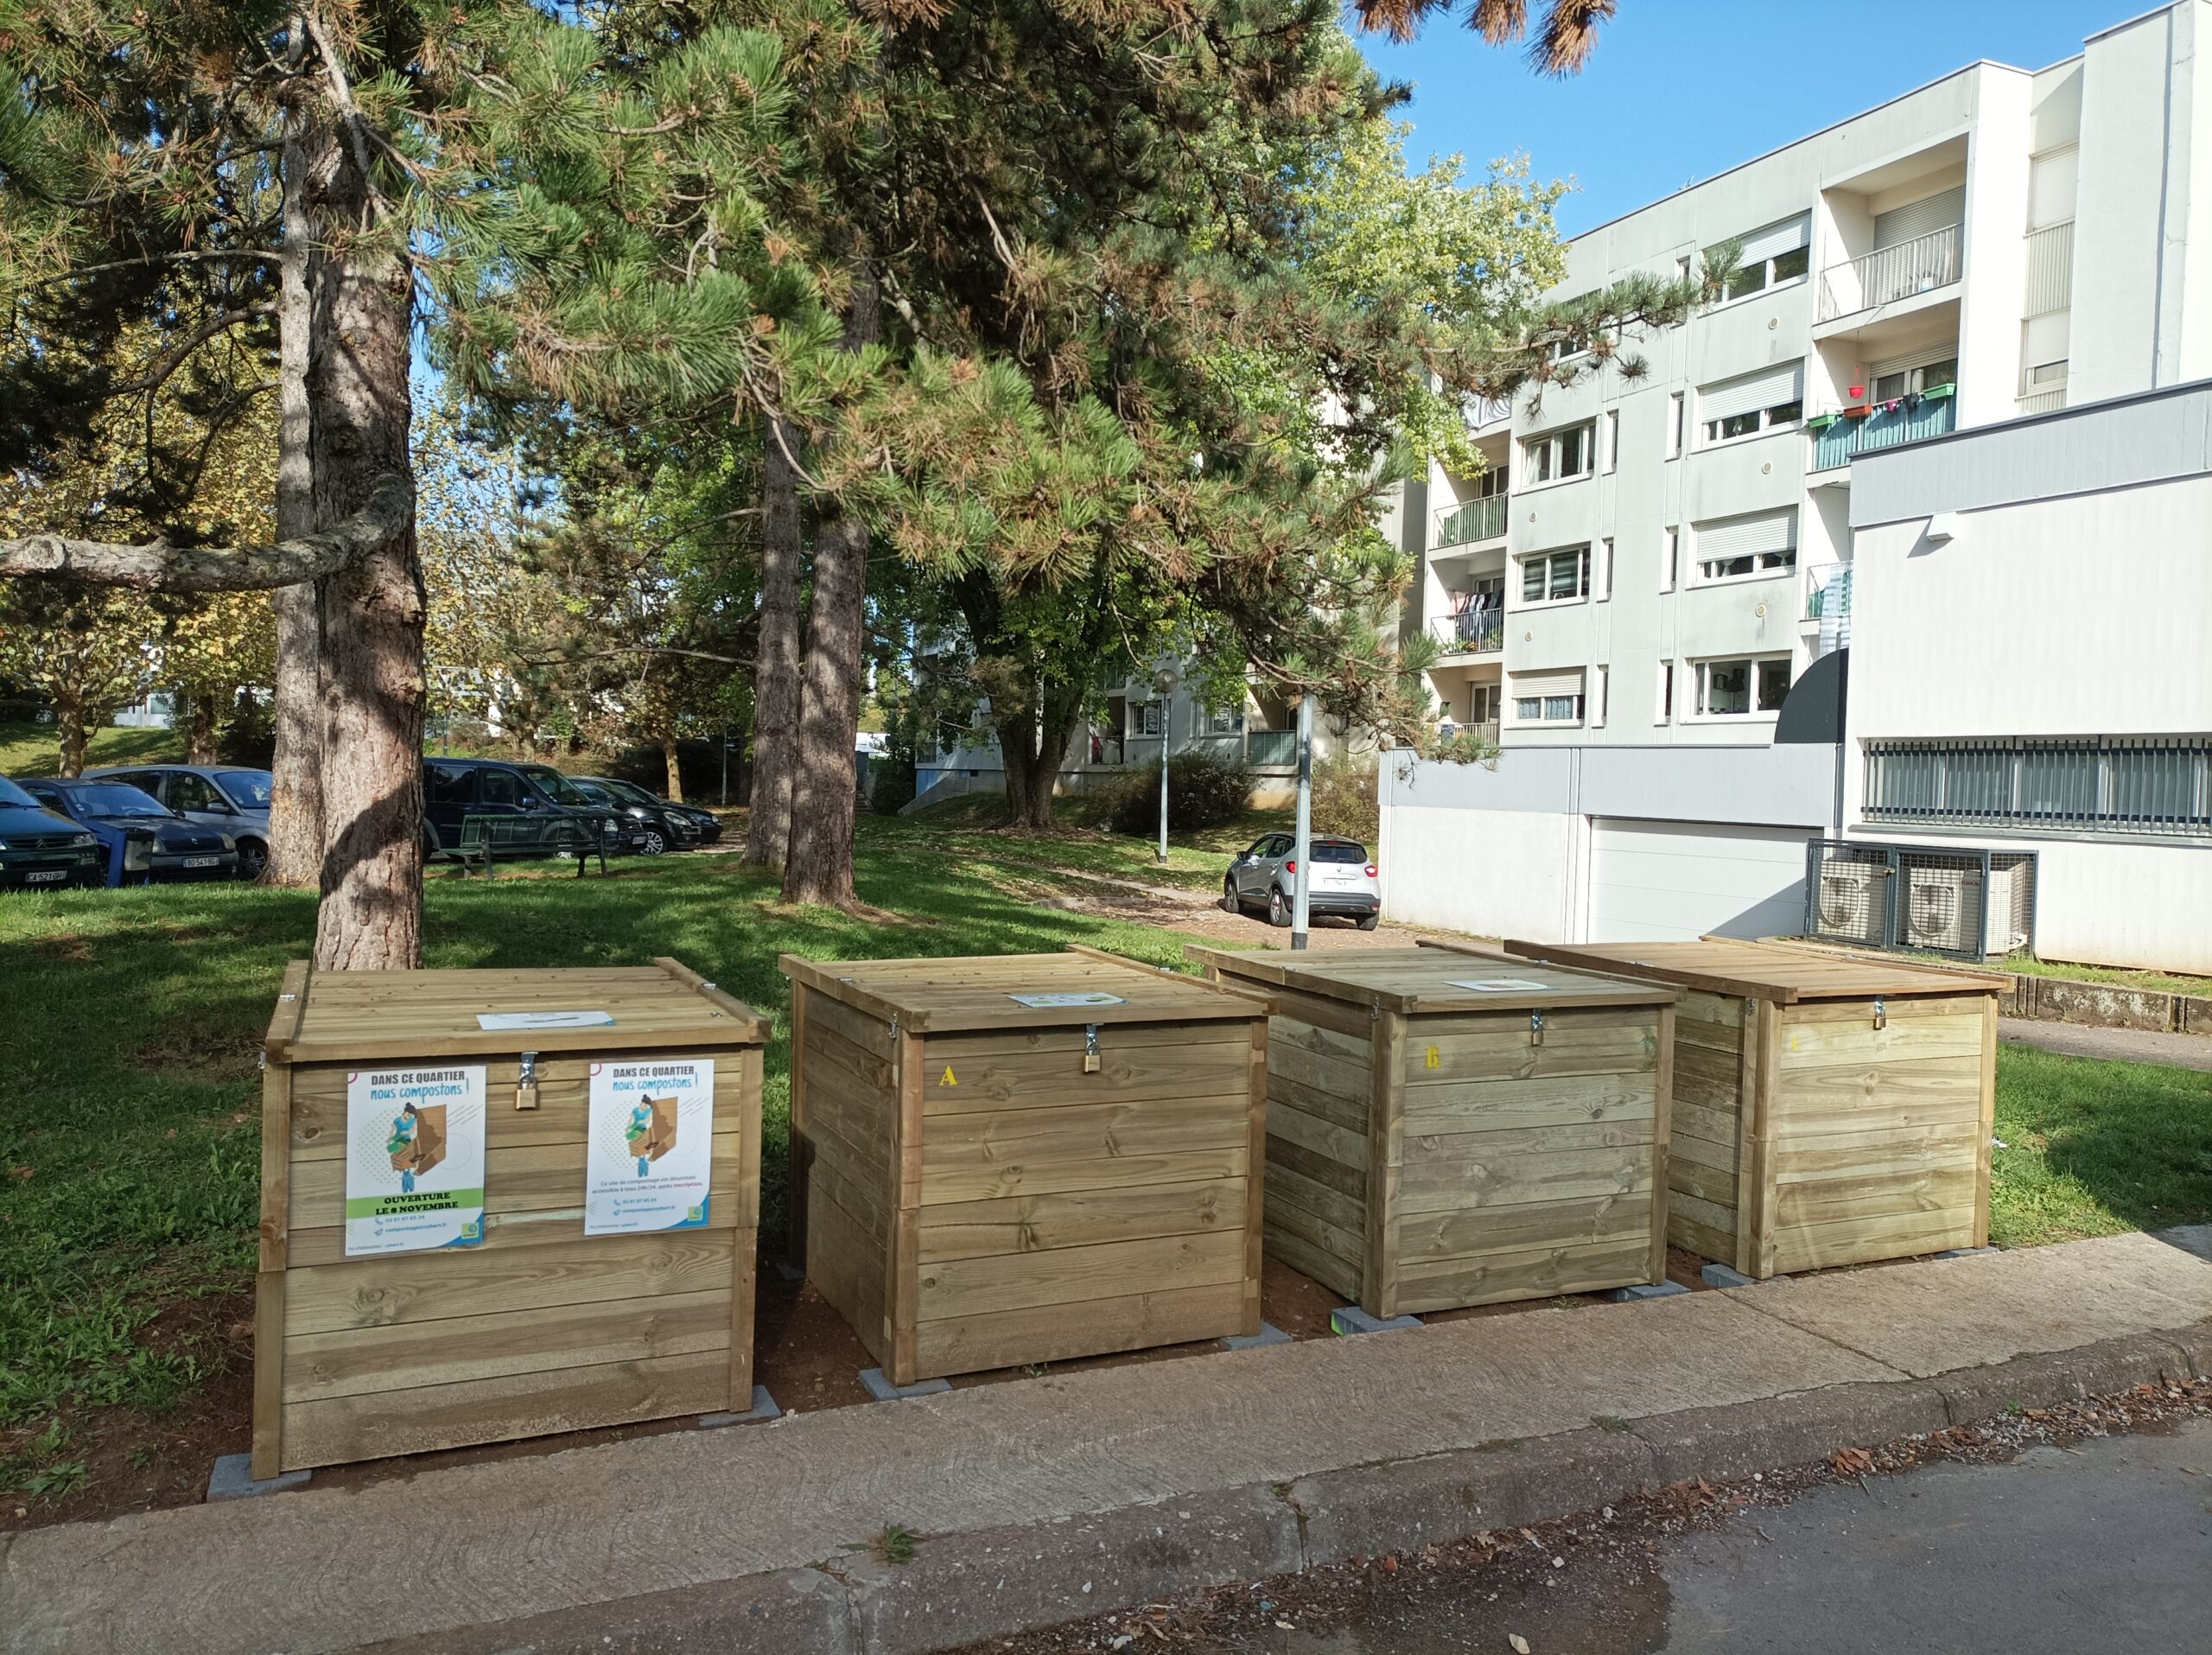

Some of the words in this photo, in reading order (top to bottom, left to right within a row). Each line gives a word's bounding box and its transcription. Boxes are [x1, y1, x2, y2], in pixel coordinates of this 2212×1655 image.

[1426, 1047, 1440, 1069] B
[372, 1073, 399, 1085] DANS
[402, 1073, 414, 1084] CE
[416, 1071, 465, 1084] QUARTIER
[613, 1067, 637, 1078] DANS
[639, 1067, 650, 1077] CE
[652, 1066, 694, 1077] QUARTIER
[939, 1065, 958, 1086] A
[371, 1088, 396, 1100] nous
[399, 1083, 462, 1104] compostons
[613, 1081, 634, 1091] nous
[638, 1077, 692, 1096] compostons
[627, 1177, 659, 1187] compostage
[384, 1193, 451, 1204] OUVERTURE
[399, 1201, 460, 1213] NOVEMBRE
